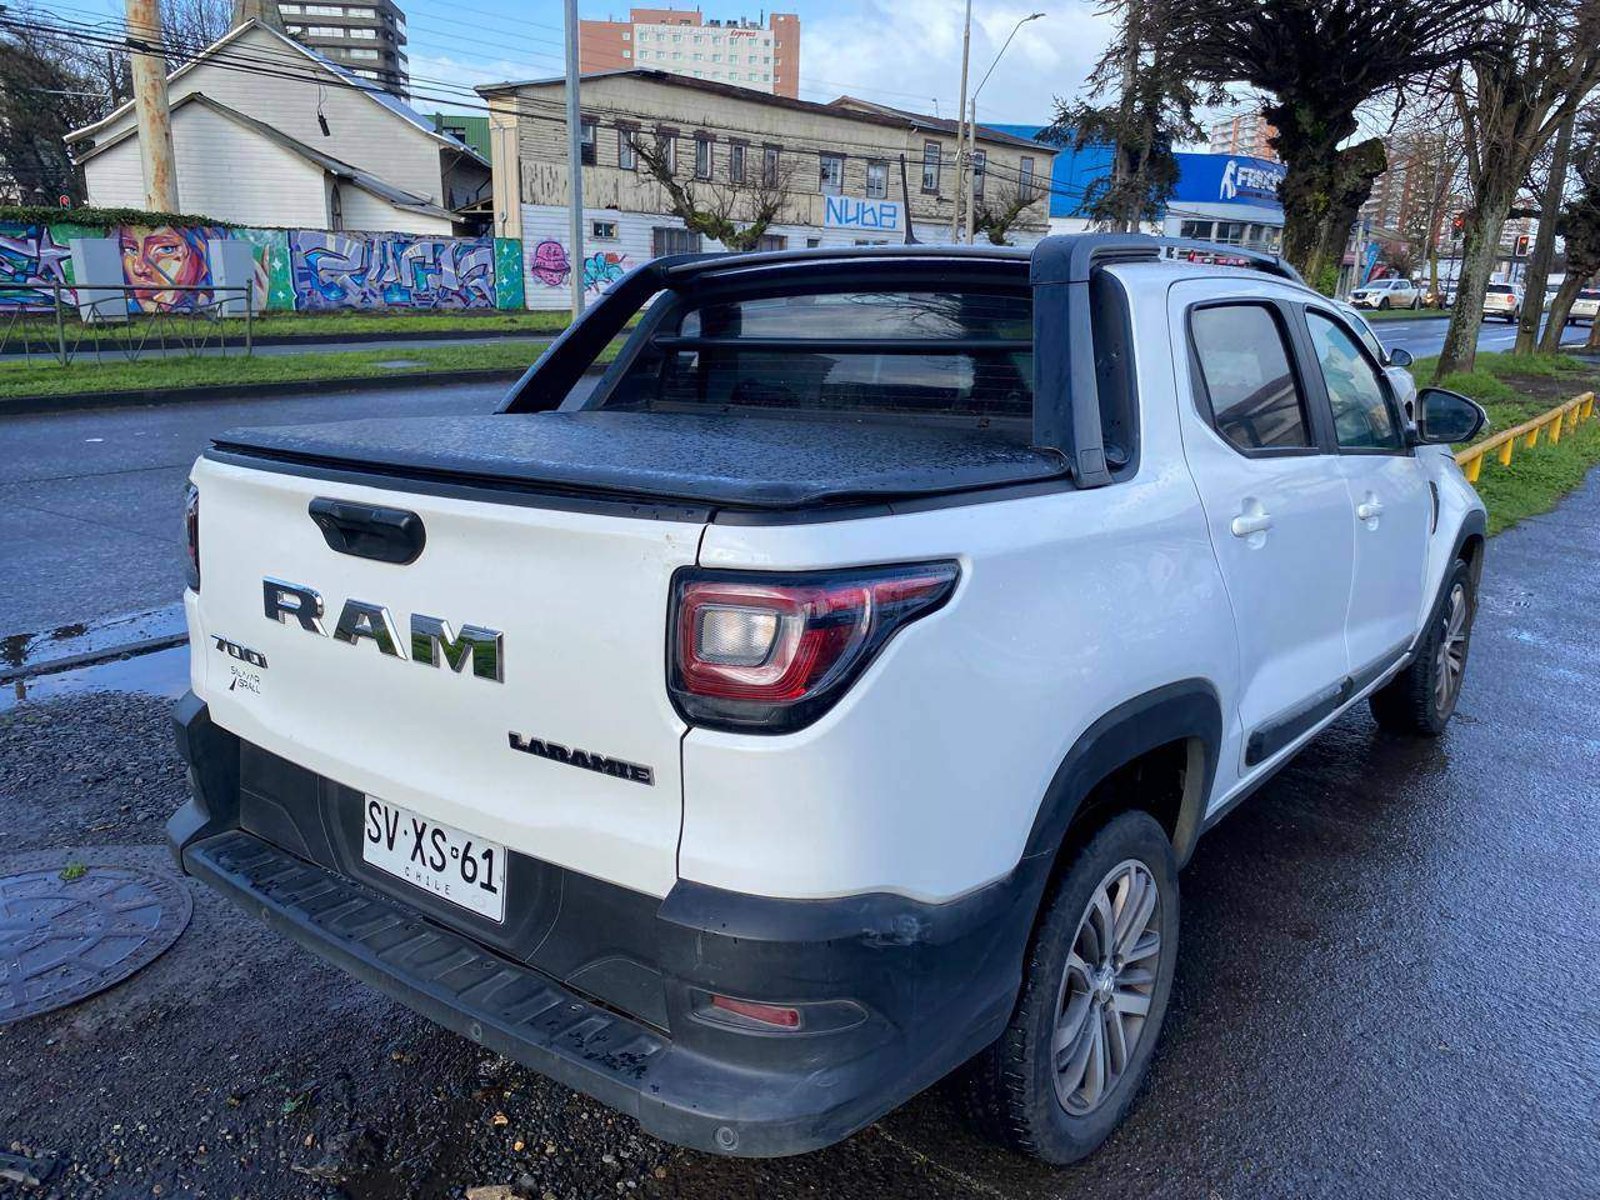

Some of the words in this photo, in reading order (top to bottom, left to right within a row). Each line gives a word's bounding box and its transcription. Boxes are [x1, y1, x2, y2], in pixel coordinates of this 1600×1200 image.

[729, 29, 757, 40] Express
[262, 575, 505, 685] RAM
[209, 634, 269, 669] 700
[508, 730, 656, 787] LARAMIE
[404, 866, 451, 896] CHILE
